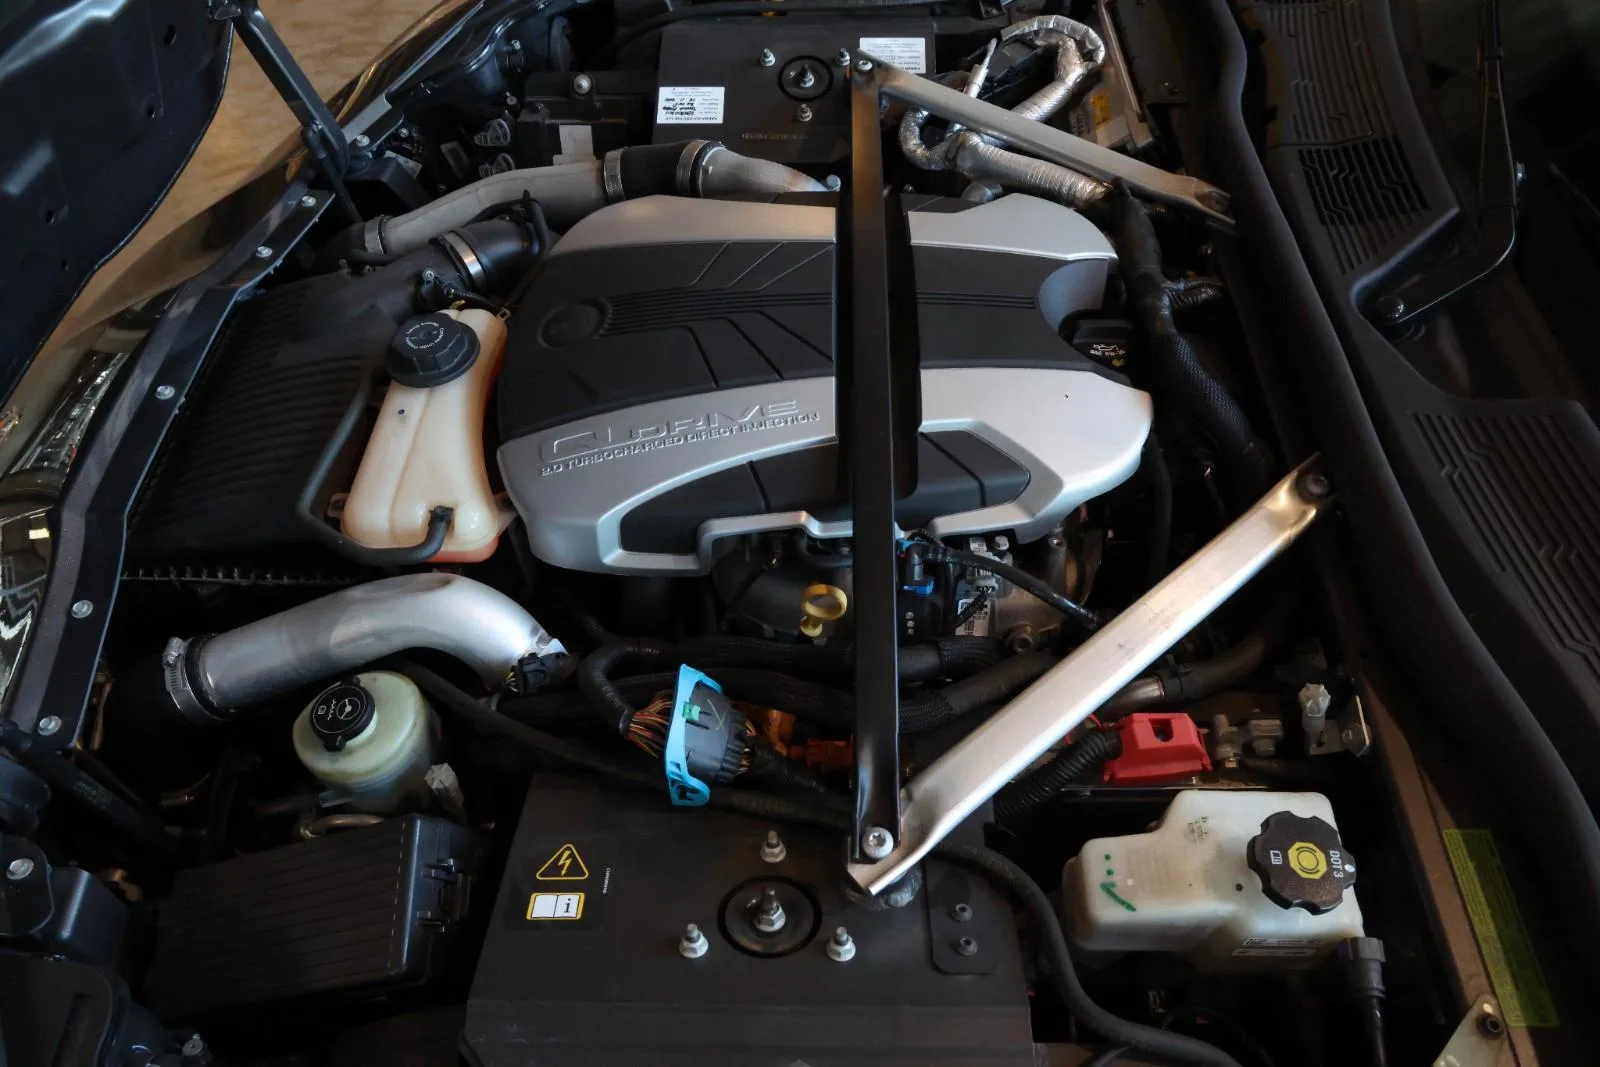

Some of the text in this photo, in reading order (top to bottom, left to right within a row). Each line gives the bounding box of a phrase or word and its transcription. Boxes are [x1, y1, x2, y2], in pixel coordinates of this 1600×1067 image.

[538, 411, 820, 477] 2.0 TURBOCHARGED DIRECT INJECTION
[1329, 850, 1344, 878] DOT 3
